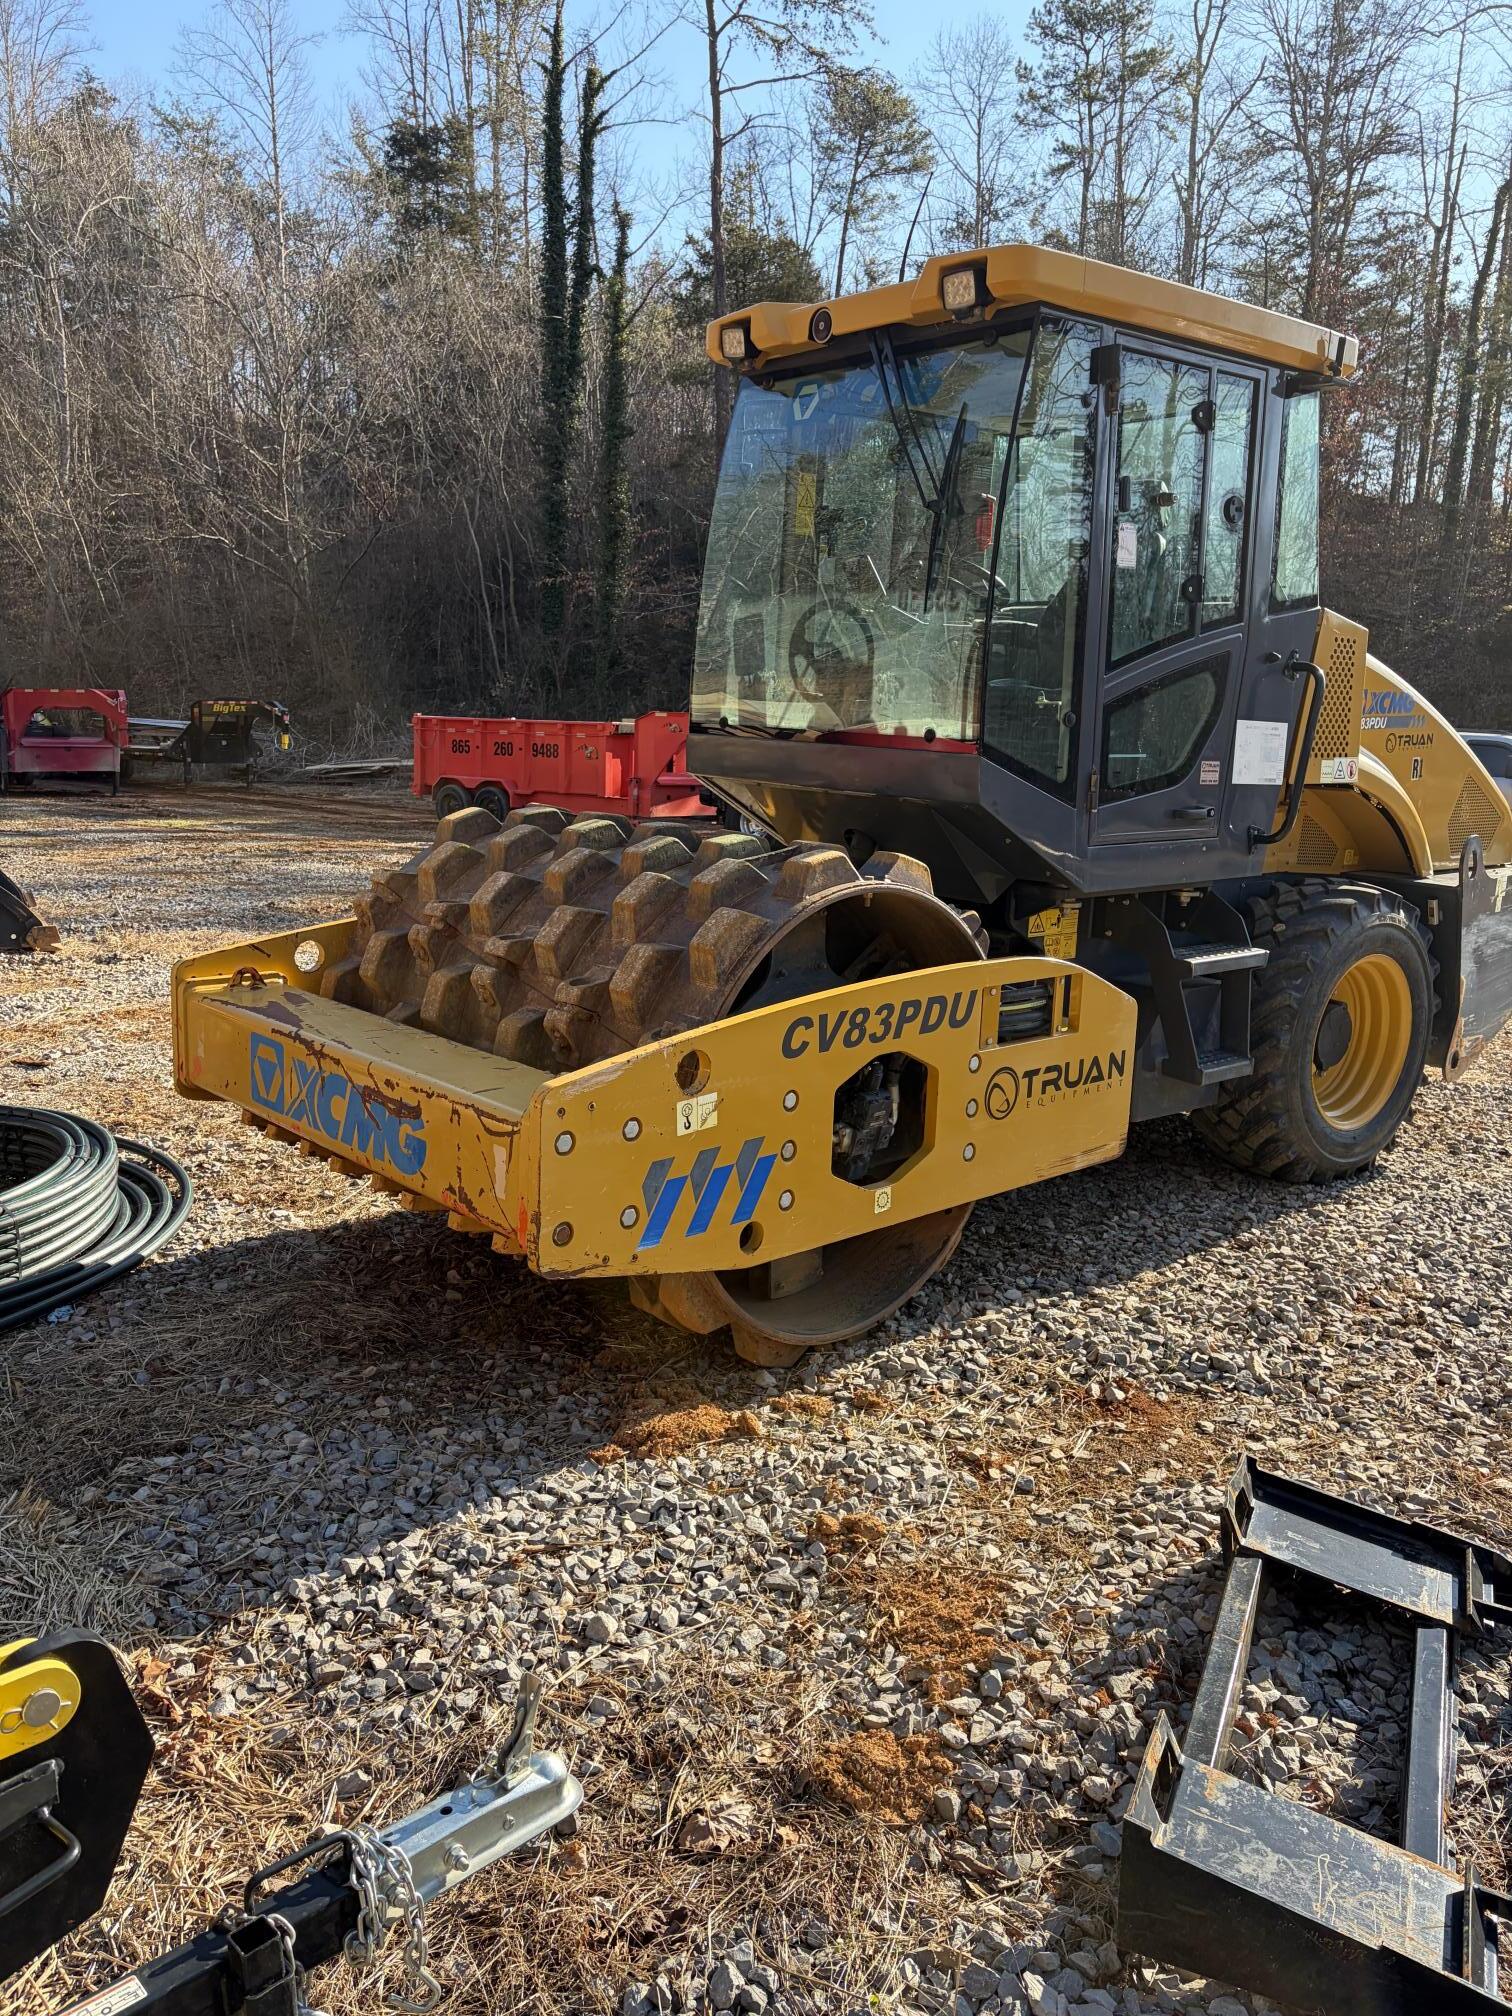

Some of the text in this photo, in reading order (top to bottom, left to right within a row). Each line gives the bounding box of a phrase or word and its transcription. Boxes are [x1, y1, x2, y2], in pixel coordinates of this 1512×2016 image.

[1367, 690, 1415, 714] XCMG
[451, 739, 559, 758] 865 260 9488
[1398, 733, 1434, 747] TRUAN
[781, 989, 979, 1060] CV83PDU
[1021, 1049, 1127, 1099] TRUAN
[1026, 1079, 1125, 1110] EQUIPMENT
[284, 1056, 427, 1176] XCMG
